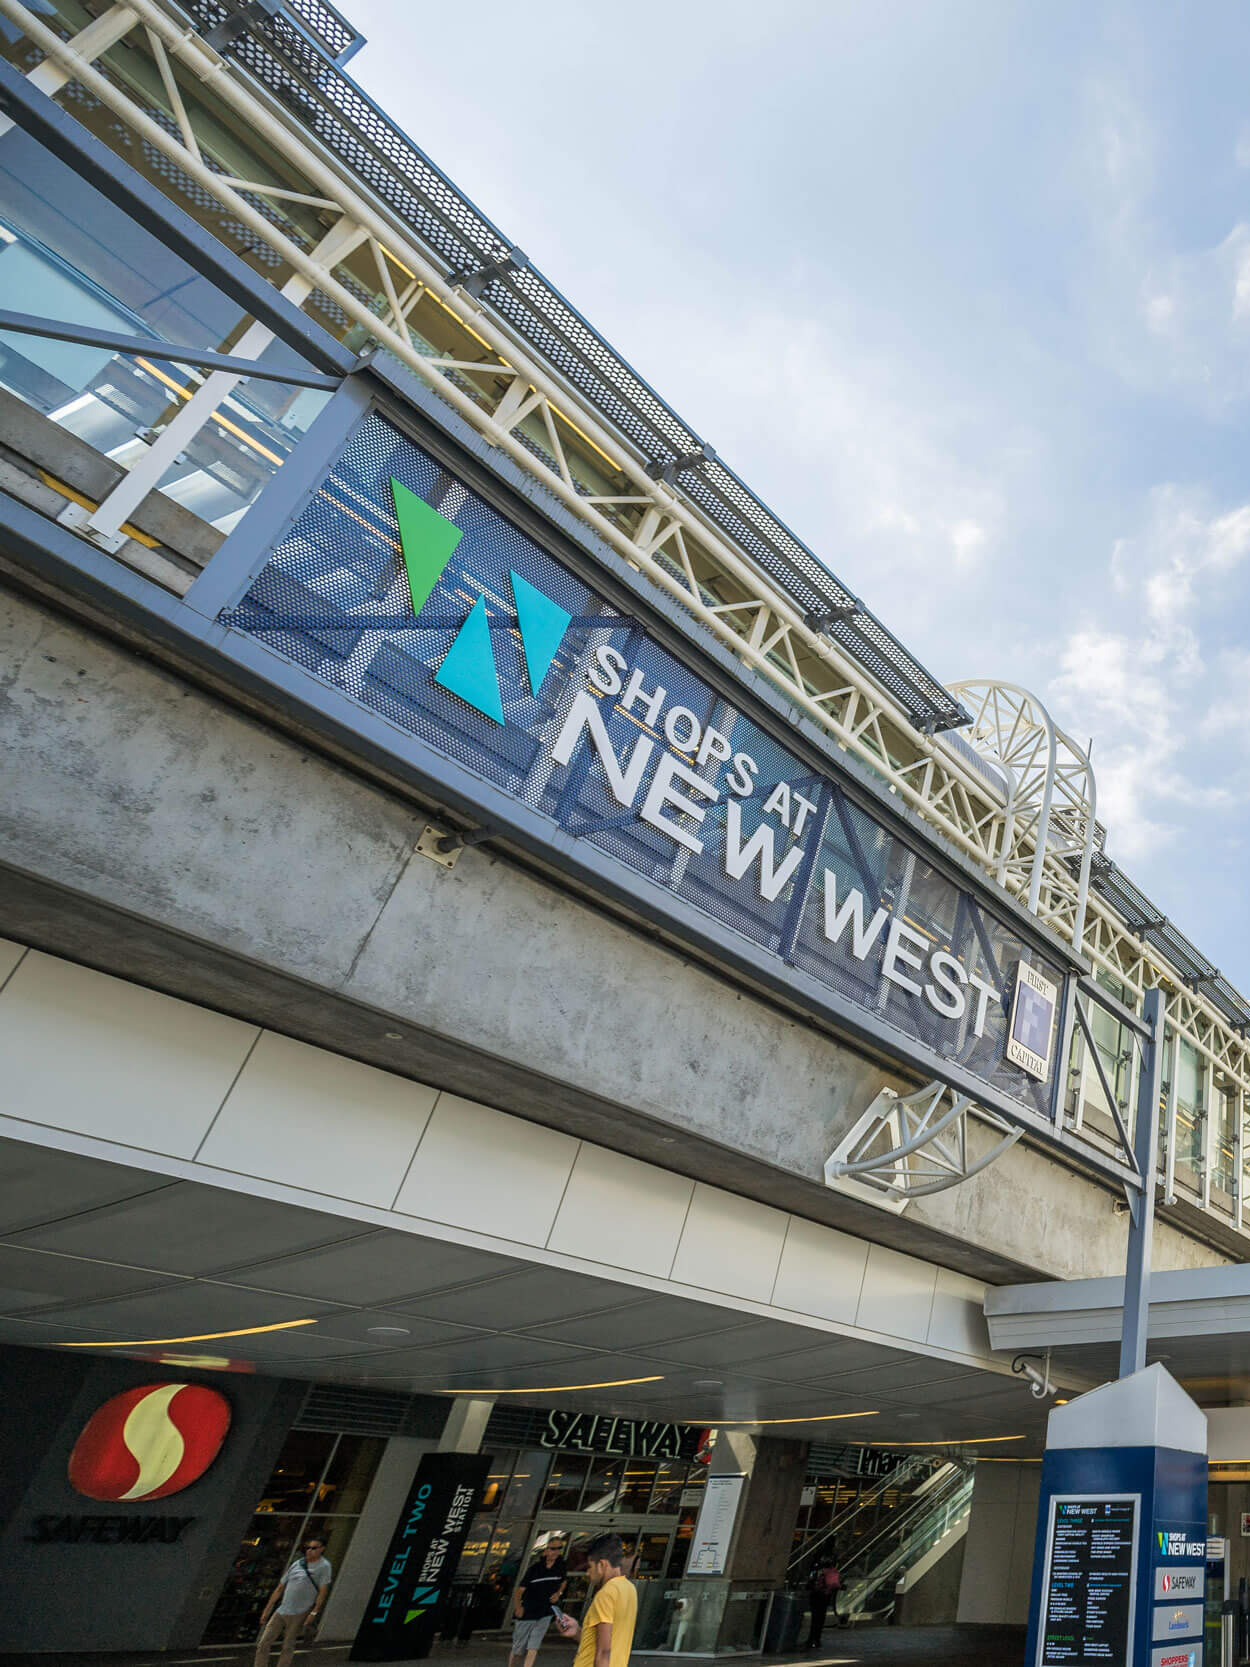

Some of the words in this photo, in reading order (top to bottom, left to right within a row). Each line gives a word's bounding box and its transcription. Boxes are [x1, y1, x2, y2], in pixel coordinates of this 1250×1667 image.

[587, 645, 758, 796] SHOPS
[763, 782, 817, 836] AT
[551, 690, 805, 901] NEW
[823, 869, 1001, 1039] WEST
[1027, 970, 1049, 996] FIRST
[1010, 1043, 1044, 1076] CAPITAL
[540, 1409, 690, 1459] SAFEWAY
[24, 1514, 196, 1544] SAFEWAY
[453, 1488, 475, 1533] STATION
[372, 1545, 411, 1623] LEVEL
[402, 1483, 432, 1539] TWO
[426, 1538, 449, 1583] NEW
[442, 1484, 467, 1535] WEST
[1168, 1542, 1186, 1556] NEW
[1186, 1543, 1206, 1557] WEST
[1171, 1576, 1197, 1590] SAFEWAY
[1160, 1653, 1189, 1666] SHOPPERS
